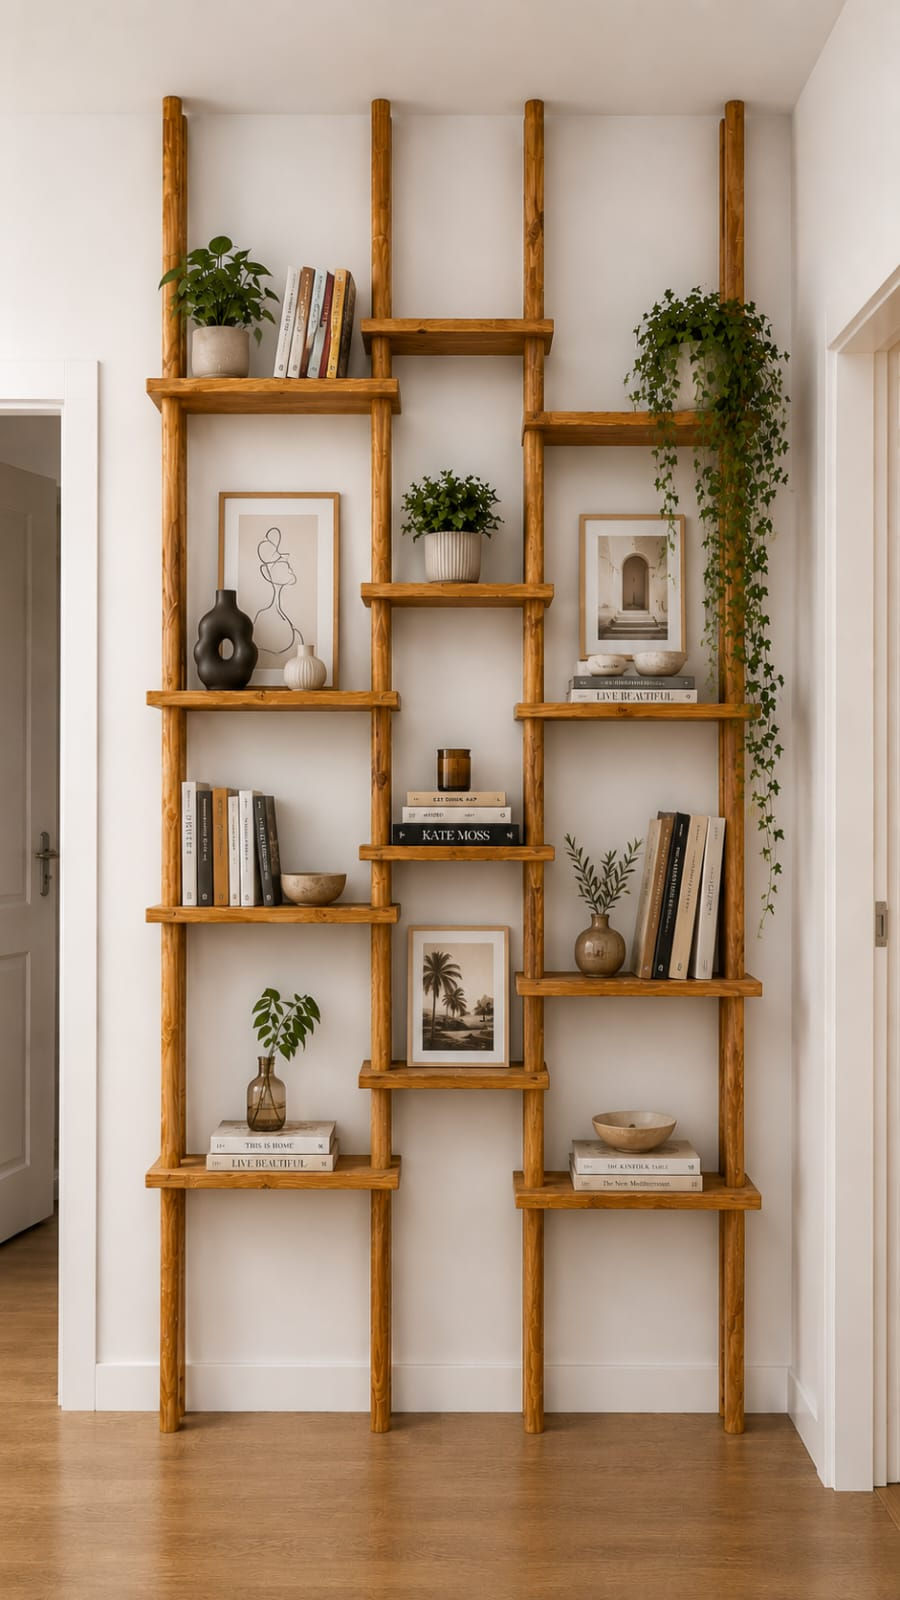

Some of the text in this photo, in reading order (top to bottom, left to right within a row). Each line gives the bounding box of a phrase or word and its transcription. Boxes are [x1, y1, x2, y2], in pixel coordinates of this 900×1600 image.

[597, 691, 674, 701] LIVE BEAUTIFUL
[422, 830, 491, 841] KATE MOSS
[232, 1159, 306, 1168] LIVE BEAUTIFUL
